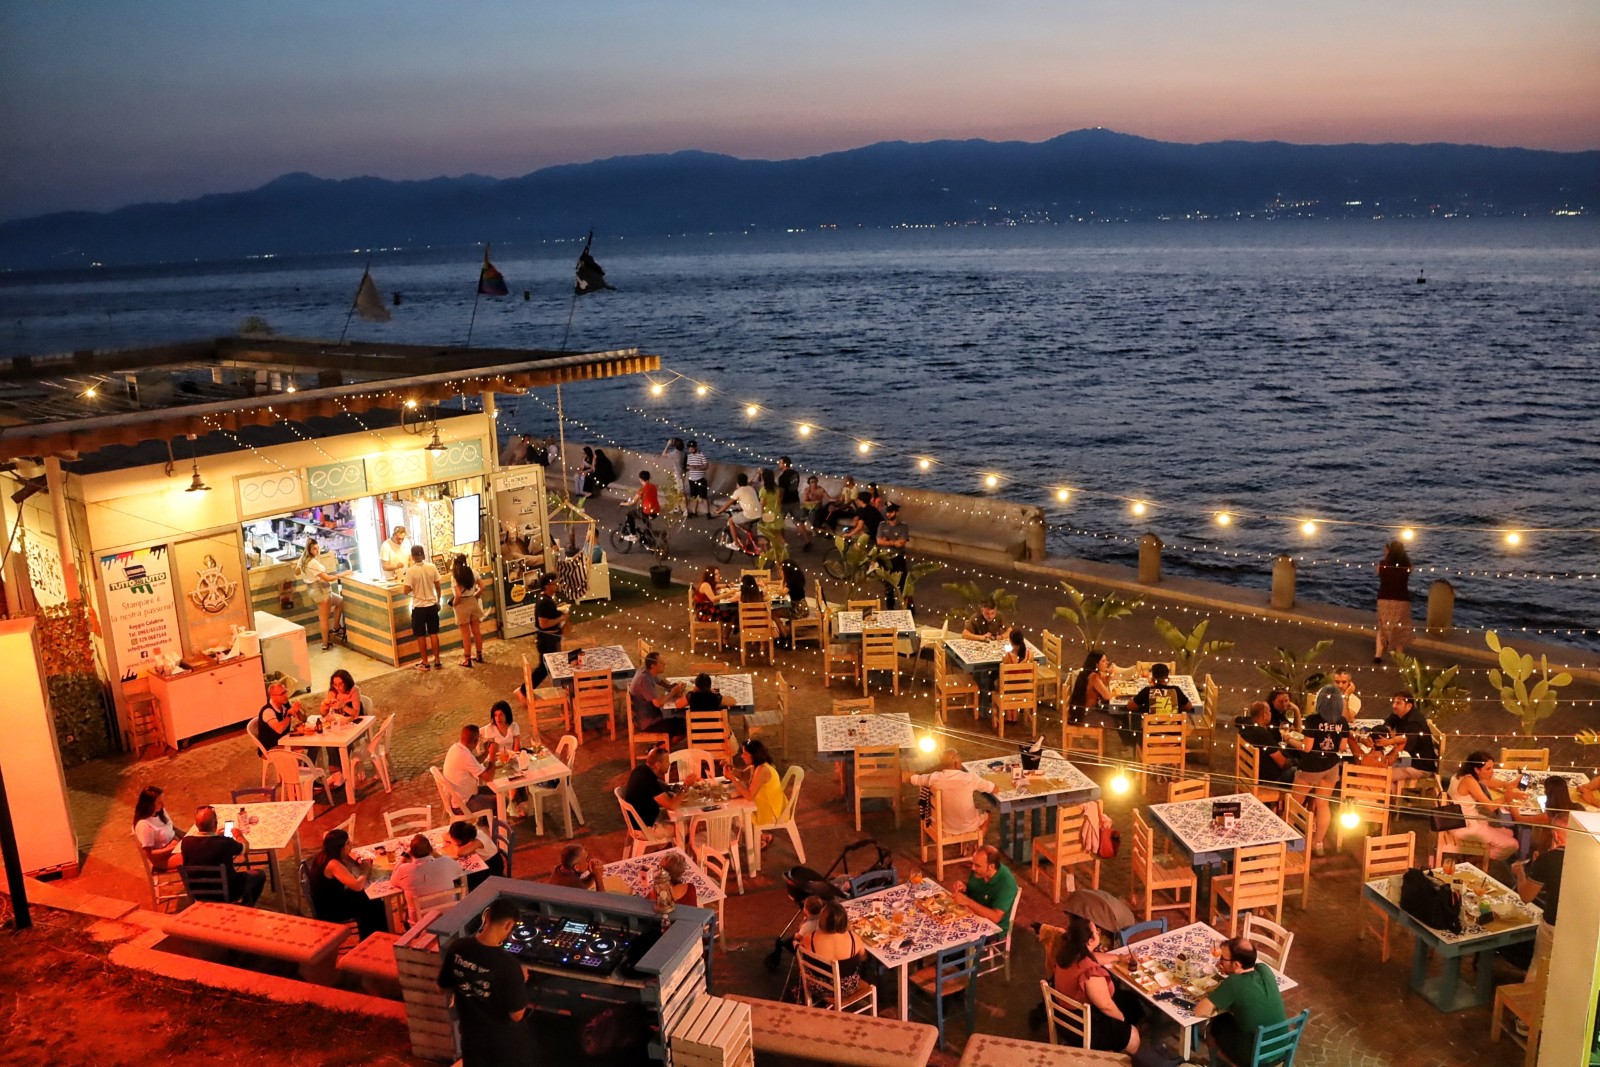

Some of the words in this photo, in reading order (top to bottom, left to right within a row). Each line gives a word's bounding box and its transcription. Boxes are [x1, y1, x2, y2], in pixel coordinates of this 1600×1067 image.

[243, 476, 296, 502] eco
[110, 580, 135, 590] TUTTO
[142, 573, 165, 583] TUTTO
[122, 599, 154, 610] Stampare
[1318, 722, 1343, 732] CREW
[454, 954, 477, 970] There
